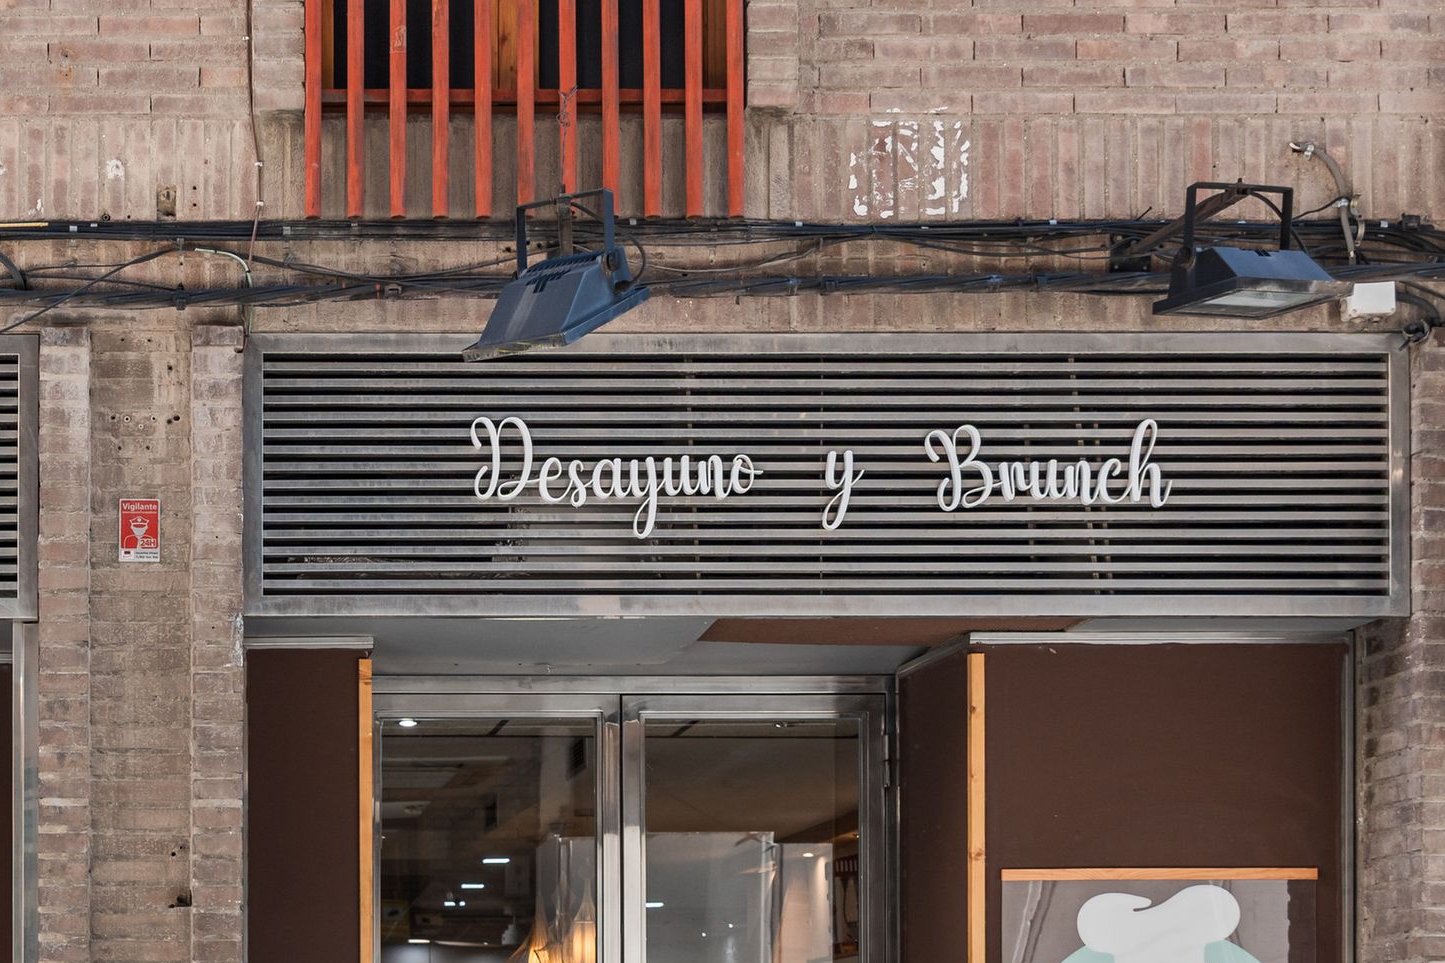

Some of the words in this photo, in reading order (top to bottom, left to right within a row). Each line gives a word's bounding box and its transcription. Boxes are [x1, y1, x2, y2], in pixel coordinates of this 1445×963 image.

[122, 502, 158, 511] Vigilante
[470, 416, 764, 539] Desayuno
[821, 449, 865, 531] y
[923, 418, 1173, 511] Brunch
